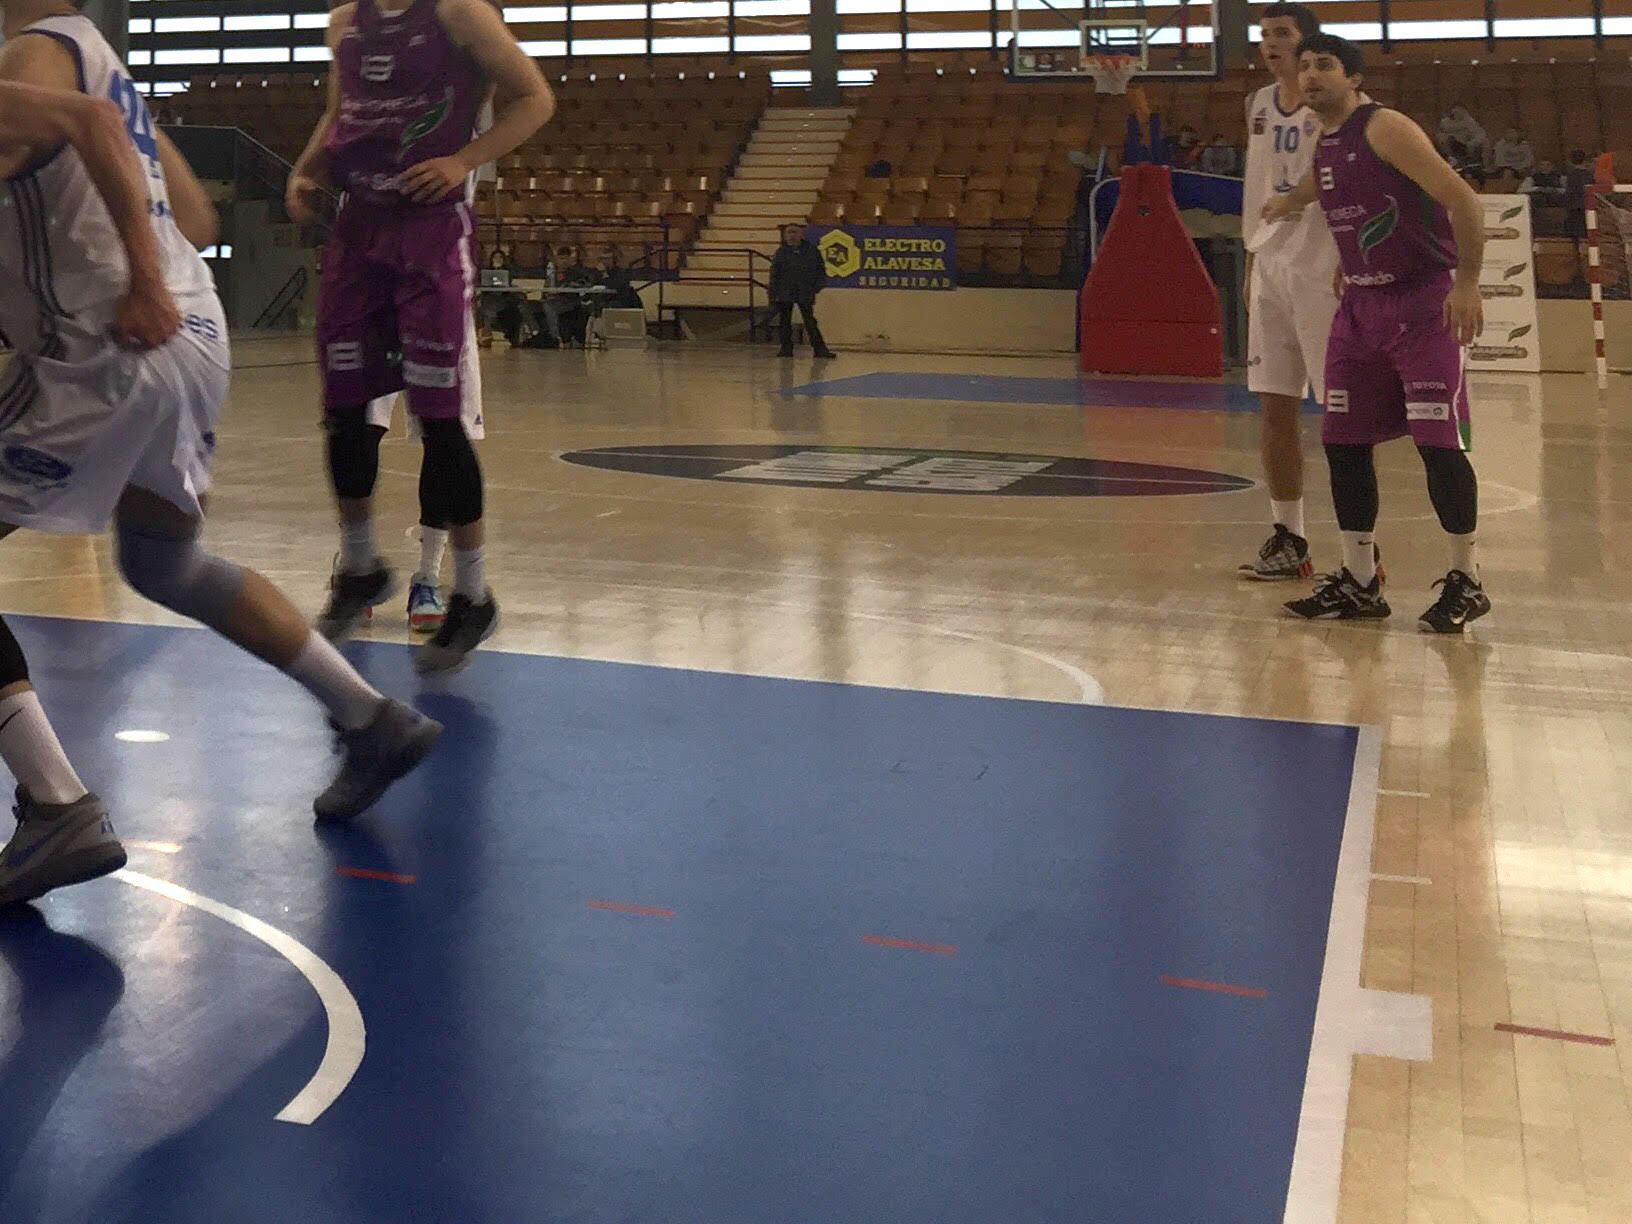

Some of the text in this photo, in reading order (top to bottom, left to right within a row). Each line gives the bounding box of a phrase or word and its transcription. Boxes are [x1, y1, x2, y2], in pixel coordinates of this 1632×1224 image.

[1271, 125, 1299, 153] 10
[863, 238, 946, 253] ELECTRO
[863, 256, 946, 271] ALAVESA
[859, 276, 951, 288] SEGURIDAD
